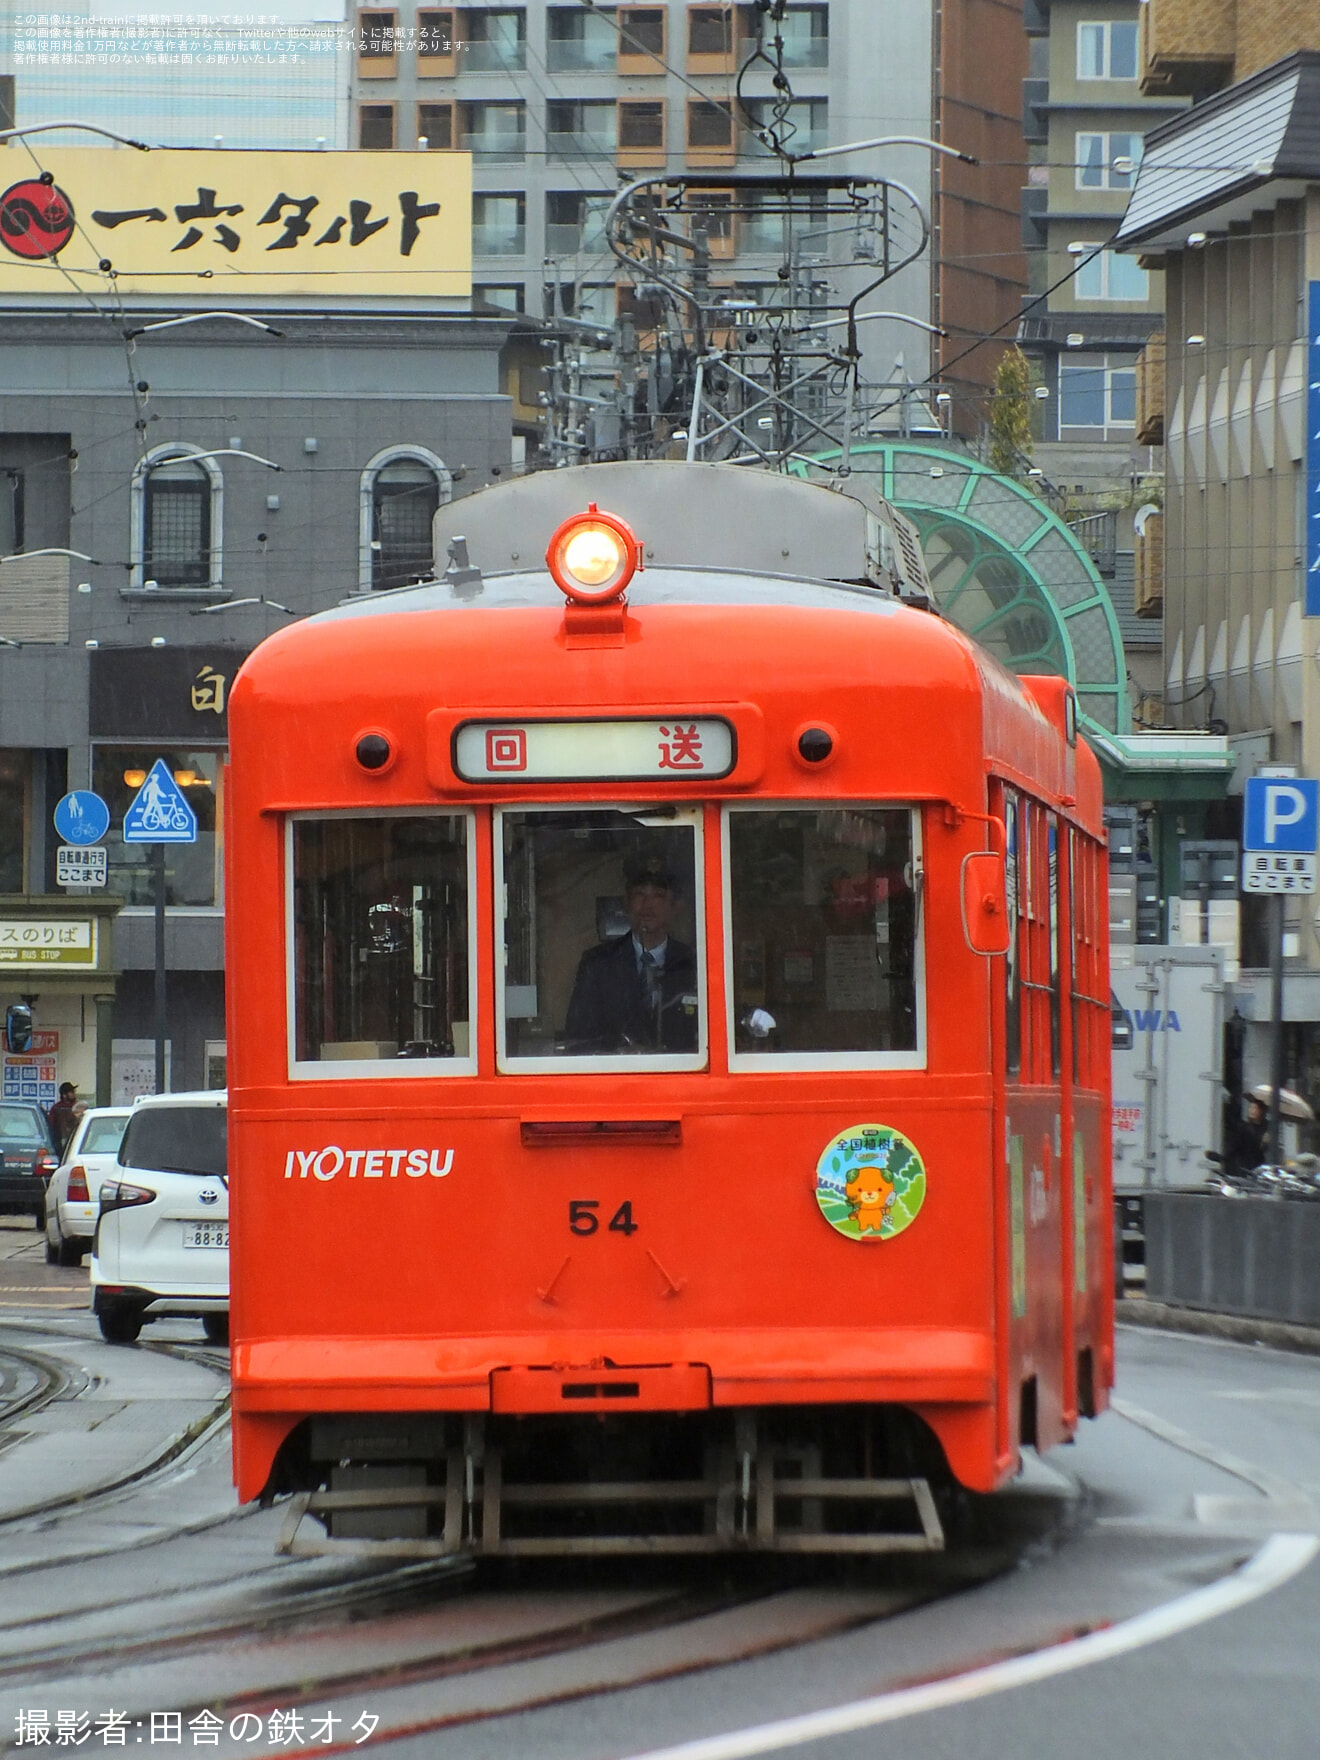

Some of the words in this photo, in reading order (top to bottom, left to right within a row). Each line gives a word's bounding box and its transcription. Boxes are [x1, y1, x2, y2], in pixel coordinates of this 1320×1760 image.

[91, 187, 441, 256] 一六タルト
[191, 665, 226, 714] 白
[1264, 785, 1306, 844] P
[59, 851, 105, 865] 自転車通行可
[1256, 858, 1305, 871] 自転車
[58, 868, 105, 882] ここまで
[1248, 875, 1312, 890] ここまで
[3, 927, 78, 943] スのりば
[21, 950, 37, 960] BUS
[40, 950, 61, 960] STOP
[284, 1146, 454, 1181] IYOTETSU
[569, 1200, 638, 1237] 54
